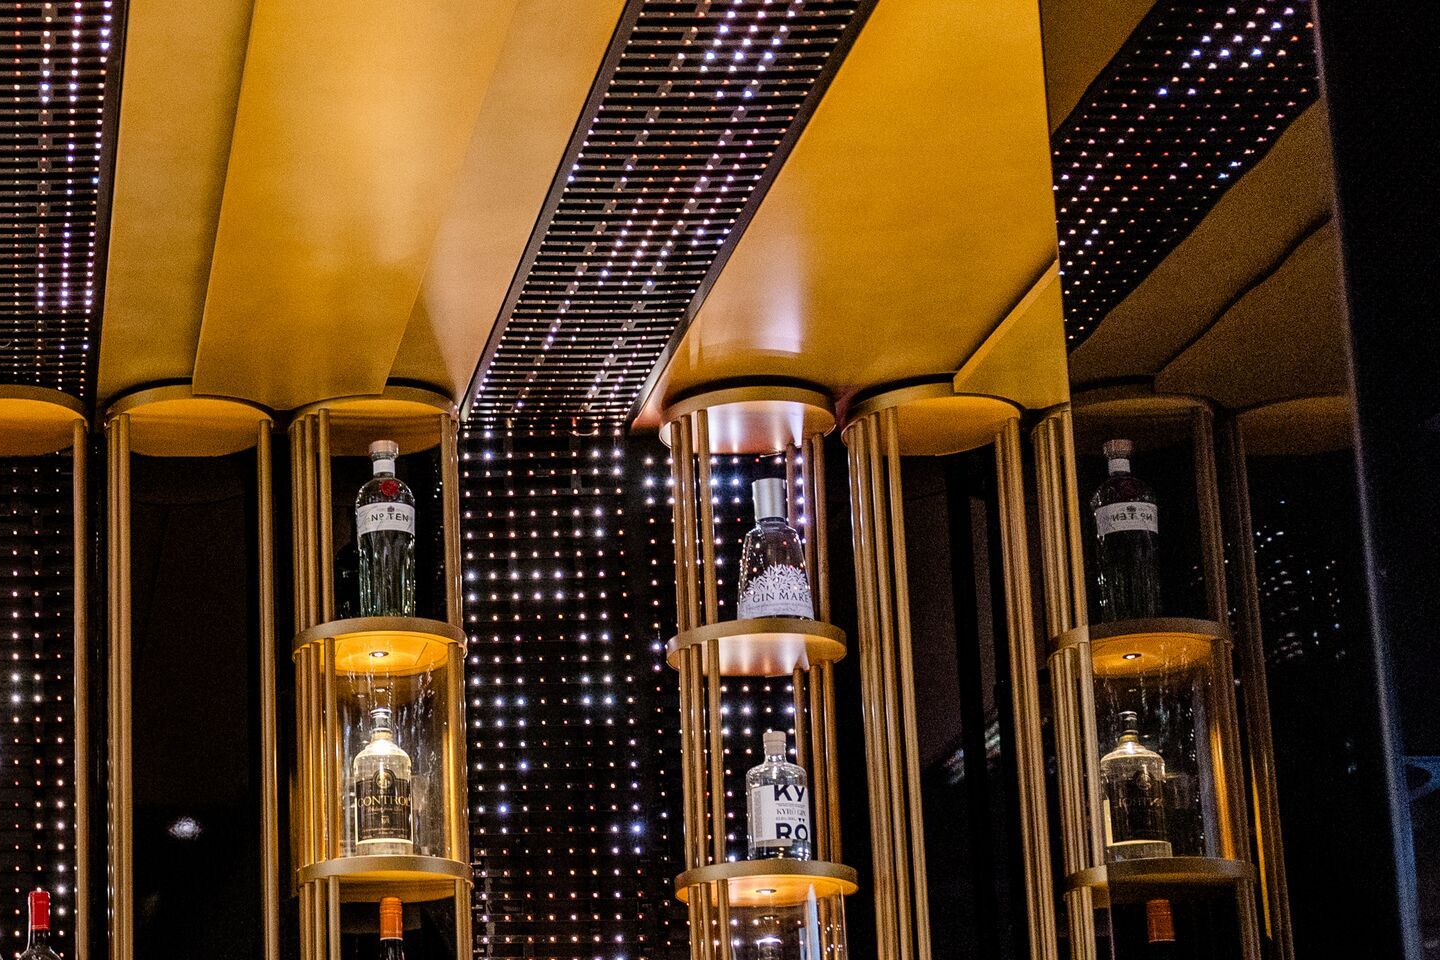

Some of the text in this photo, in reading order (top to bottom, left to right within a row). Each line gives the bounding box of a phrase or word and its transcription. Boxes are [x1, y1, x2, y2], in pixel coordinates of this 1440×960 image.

[388, 512, 409, 522] TEN
[752, 592, 809, 603] GIN MARE
[774, 784, 805, 803] KY
